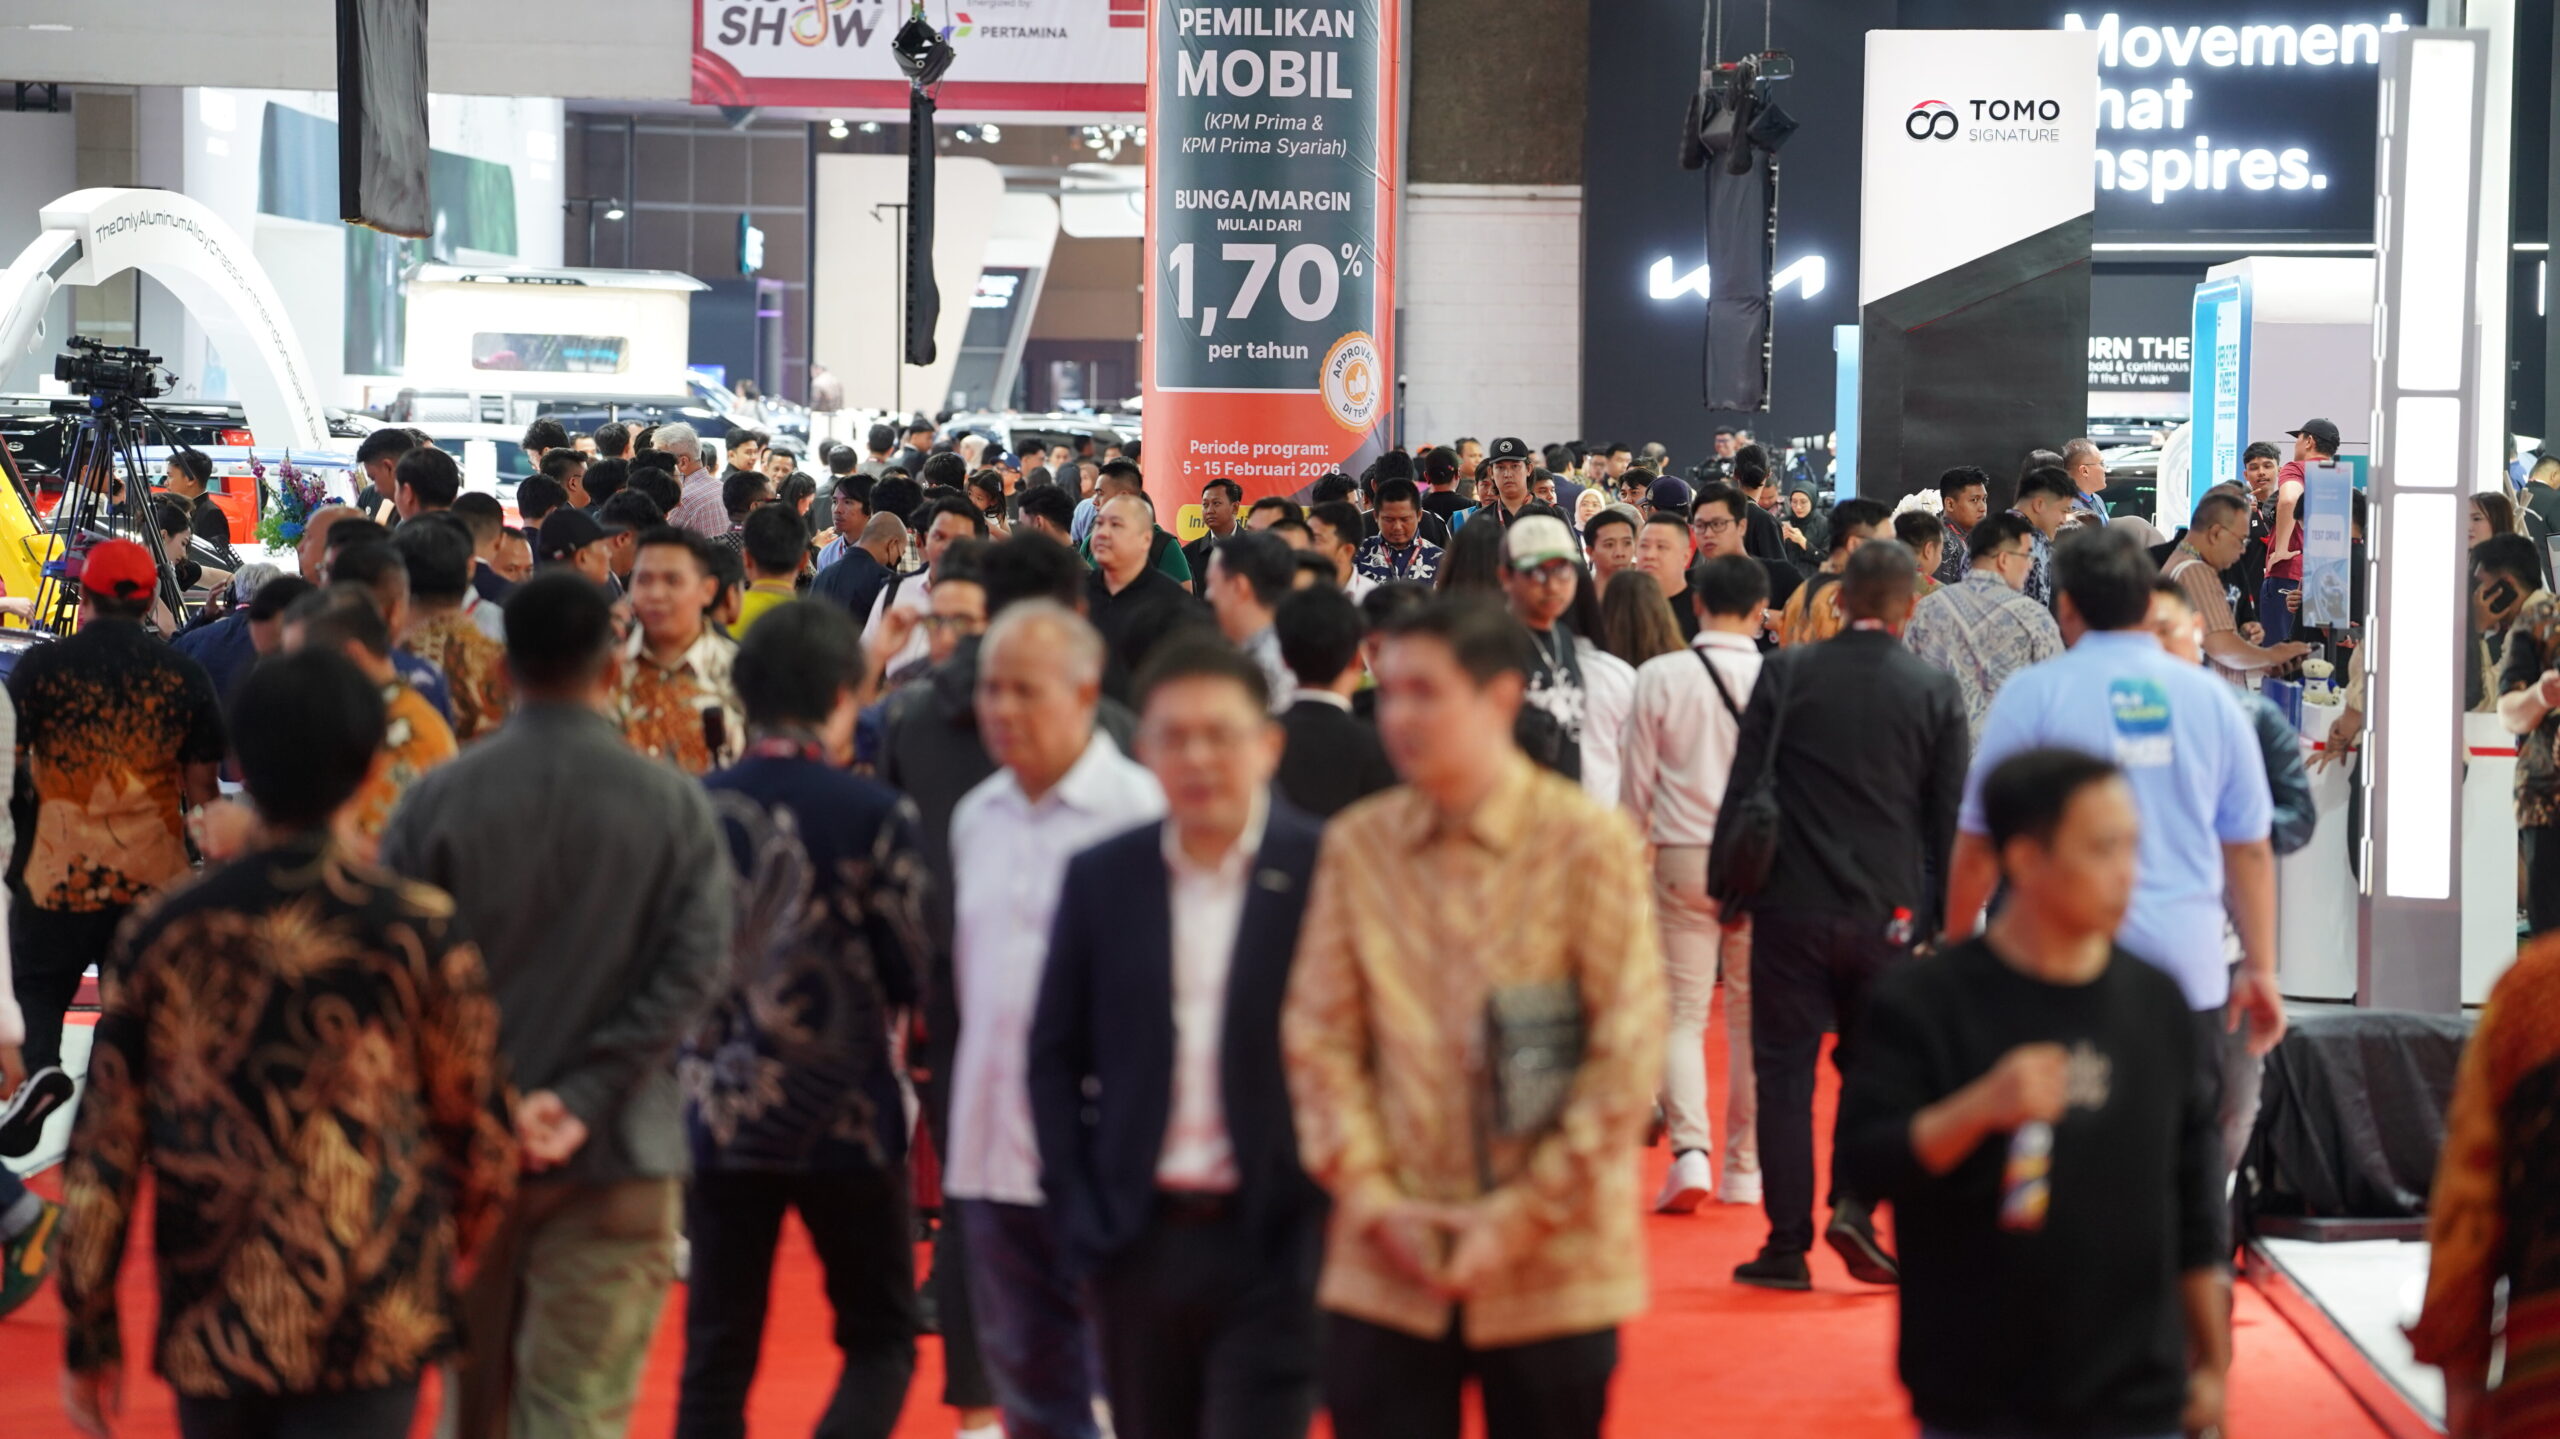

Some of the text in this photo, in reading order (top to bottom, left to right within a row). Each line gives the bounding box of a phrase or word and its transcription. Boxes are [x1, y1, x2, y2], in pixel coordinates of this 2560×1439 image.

[717, 6, 881, 47] SHOW
[1179, 7, 1355, 39] PEMILIKAN
[980, 27, 1068, 40] PERTAMINA
[1177, 49, 1353, 99] MOBIL
[1969, 99, 2061, 121] TOMO
[1204, 112, 1324, 131] (KPM Prima &
[1969, 128, 2060, 142] SIGNATURE
[1182, 137, 1347, 158] KPM Prima Syariah)
[1175, 189, 1351, 213] BUNGA/MARGIN
[1217, 219, 1302, 232] MULAI DARI
[1208, 341, 1309, 362] per tahun
[2138, 336, 2190, 360] THE
[1333, 345, 1375, 379] APPROVAL
[2126, 361, 2190, 373] continuous
[2121, 372, 2138, 385] EV
[2139, 374, 2170, 385] wave
[1342, 402, 1353, 415] DI
[1190, 440, 1329, 458] Periode program:
[1183, 461, 1192, 475] 5
[1203, 461, 1221, 475] 15
[1224, 461, 1296, 476] Februari
[1299, 462, 1341, 477] 2026
